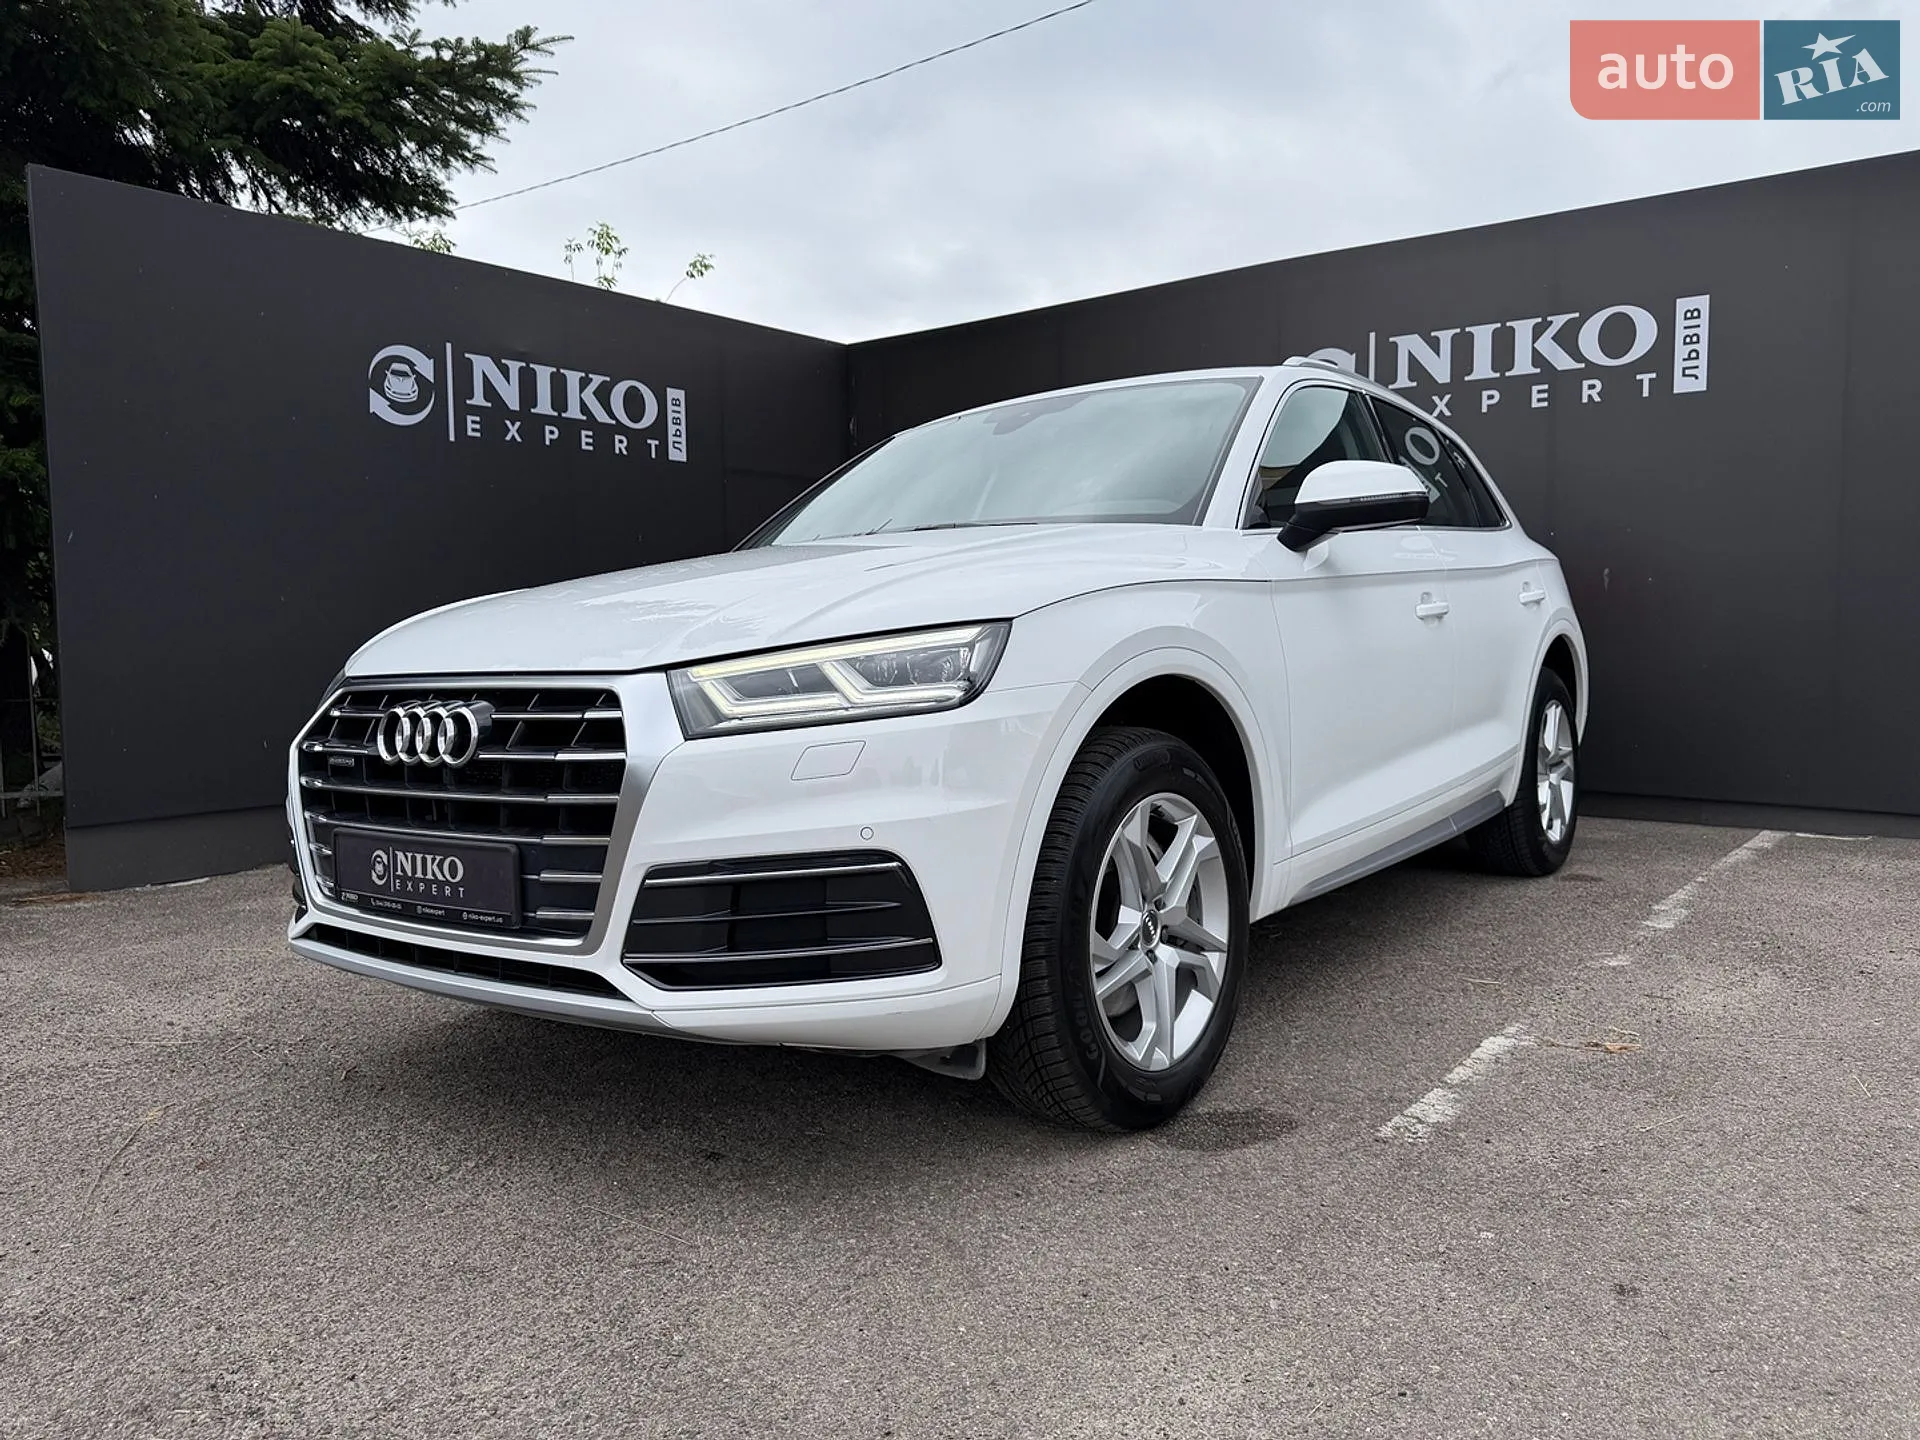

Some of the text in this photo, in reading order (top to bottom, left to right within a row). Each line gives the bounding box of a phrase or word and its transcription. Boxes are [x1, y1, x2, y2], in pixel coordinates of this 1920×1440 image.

[1388, 304, 1658, 390] NIKO
[1681, 306, 1702, 381] ЛЬВІВ
[463, 352, 658, 429] NIKO
[1431, 372, 1657, 417] XPERT
[466, 415, 660, 459] EXPERT
[671, 396, 683, 453] ЛЬВІВ
[394, 850, 464, 883] NIKO
[395, 879, 465, 898] EXPERT
